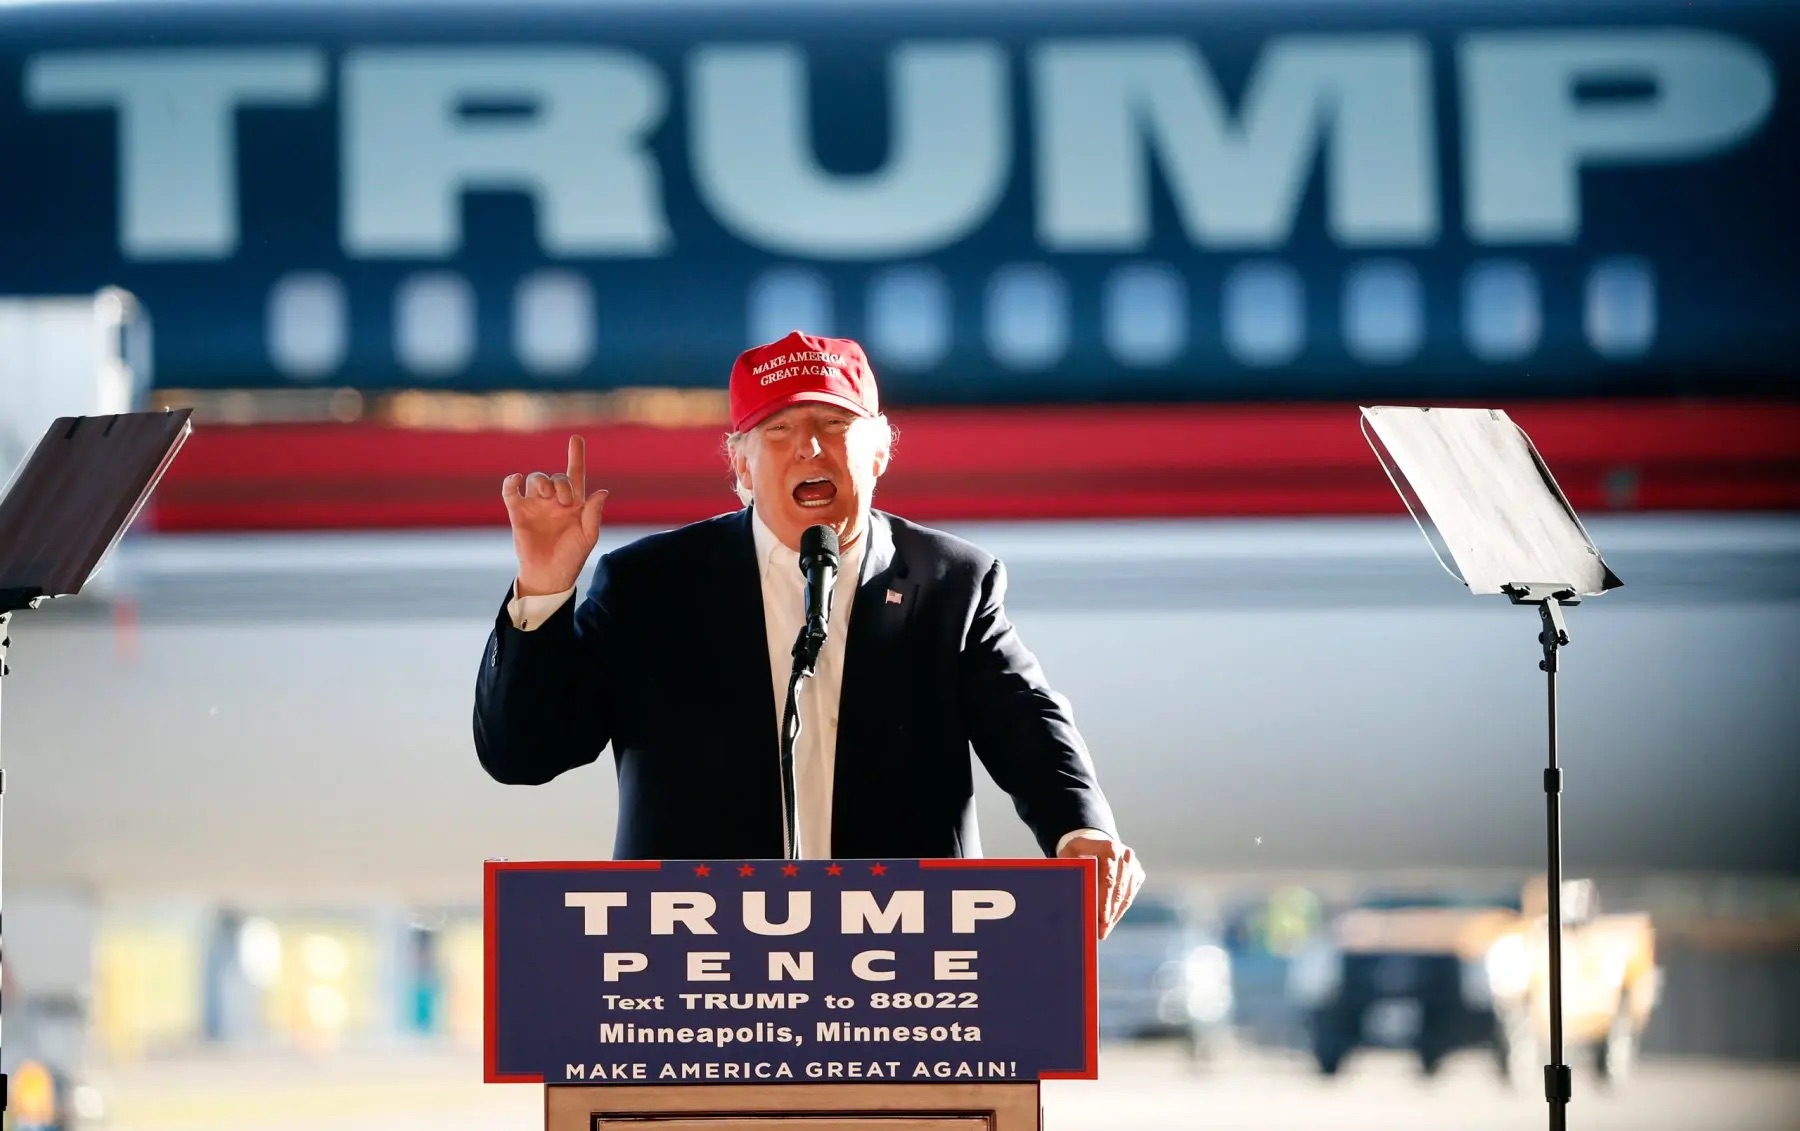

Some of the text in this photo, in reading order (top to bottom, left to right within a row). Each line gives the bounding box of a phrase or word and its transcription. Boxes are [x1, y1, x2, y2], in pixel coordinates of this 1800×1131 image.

[25, 32, 1776, 260] TRUMP
[752, 351, 847, 376] MAKE AMERICA
[760, 366, 800, 386] GREAT
[564, 890, 1017, 936] TRUMP
[603, 950, 979, 982] PENCE
[602, 992, 979, 1010] Text TRUMP to 88022
[600, 1021, 981, 1048] Minneapolis, Minnesota
[566, 1061, 1017, 1080] MAKE AMERICA GREAT AGAIN!
